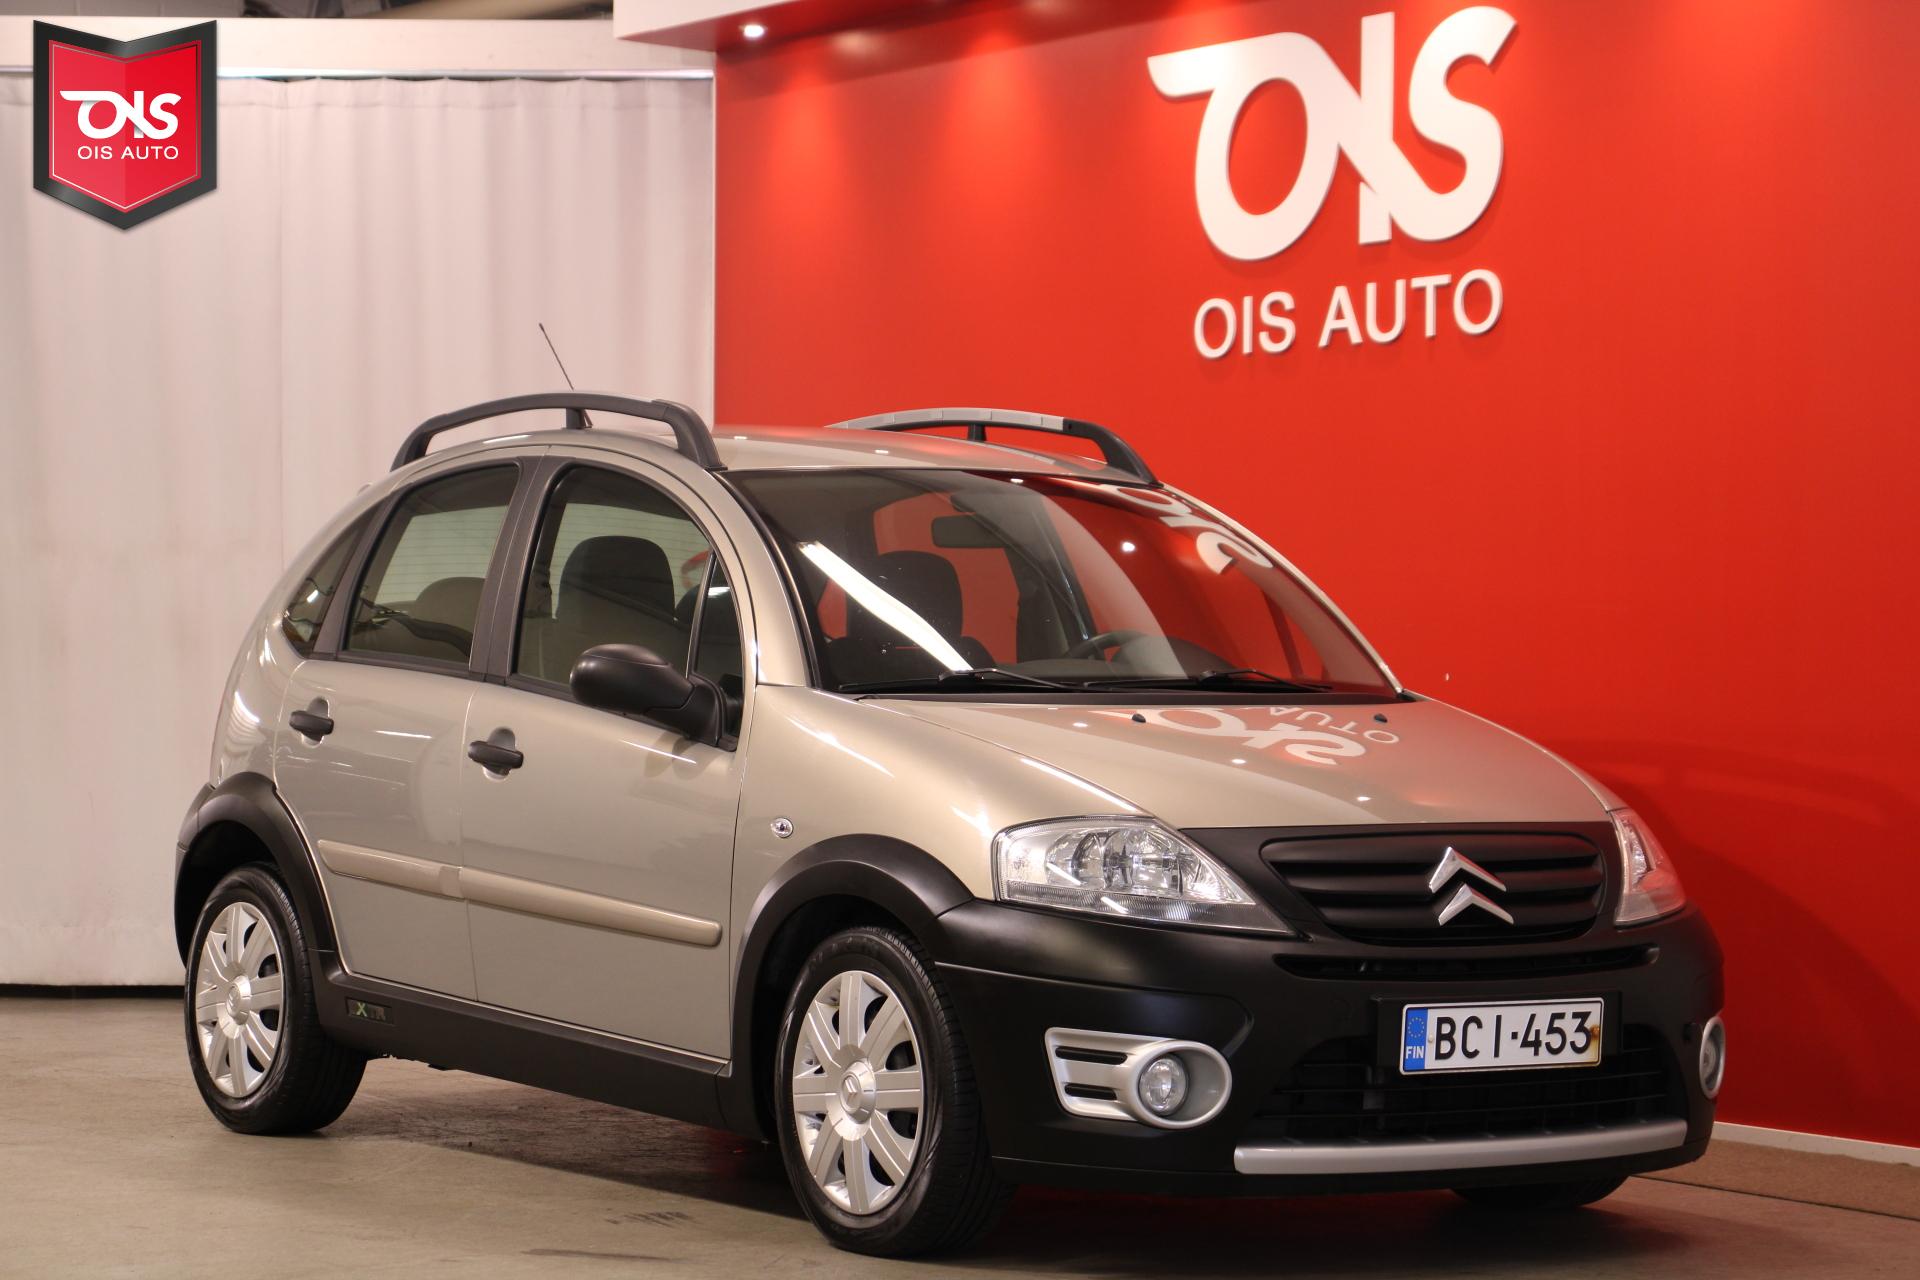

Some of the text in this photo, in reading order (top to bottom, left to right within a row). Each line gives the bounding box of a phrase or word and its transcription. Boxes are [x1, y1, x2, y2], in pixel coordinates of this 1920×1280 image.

[1194, 269, 1503, 359] OIS AUTO
[1405, 1045, 1425, 1060] FIN
[1434, 1011, 1592, 1061] BCI-453
